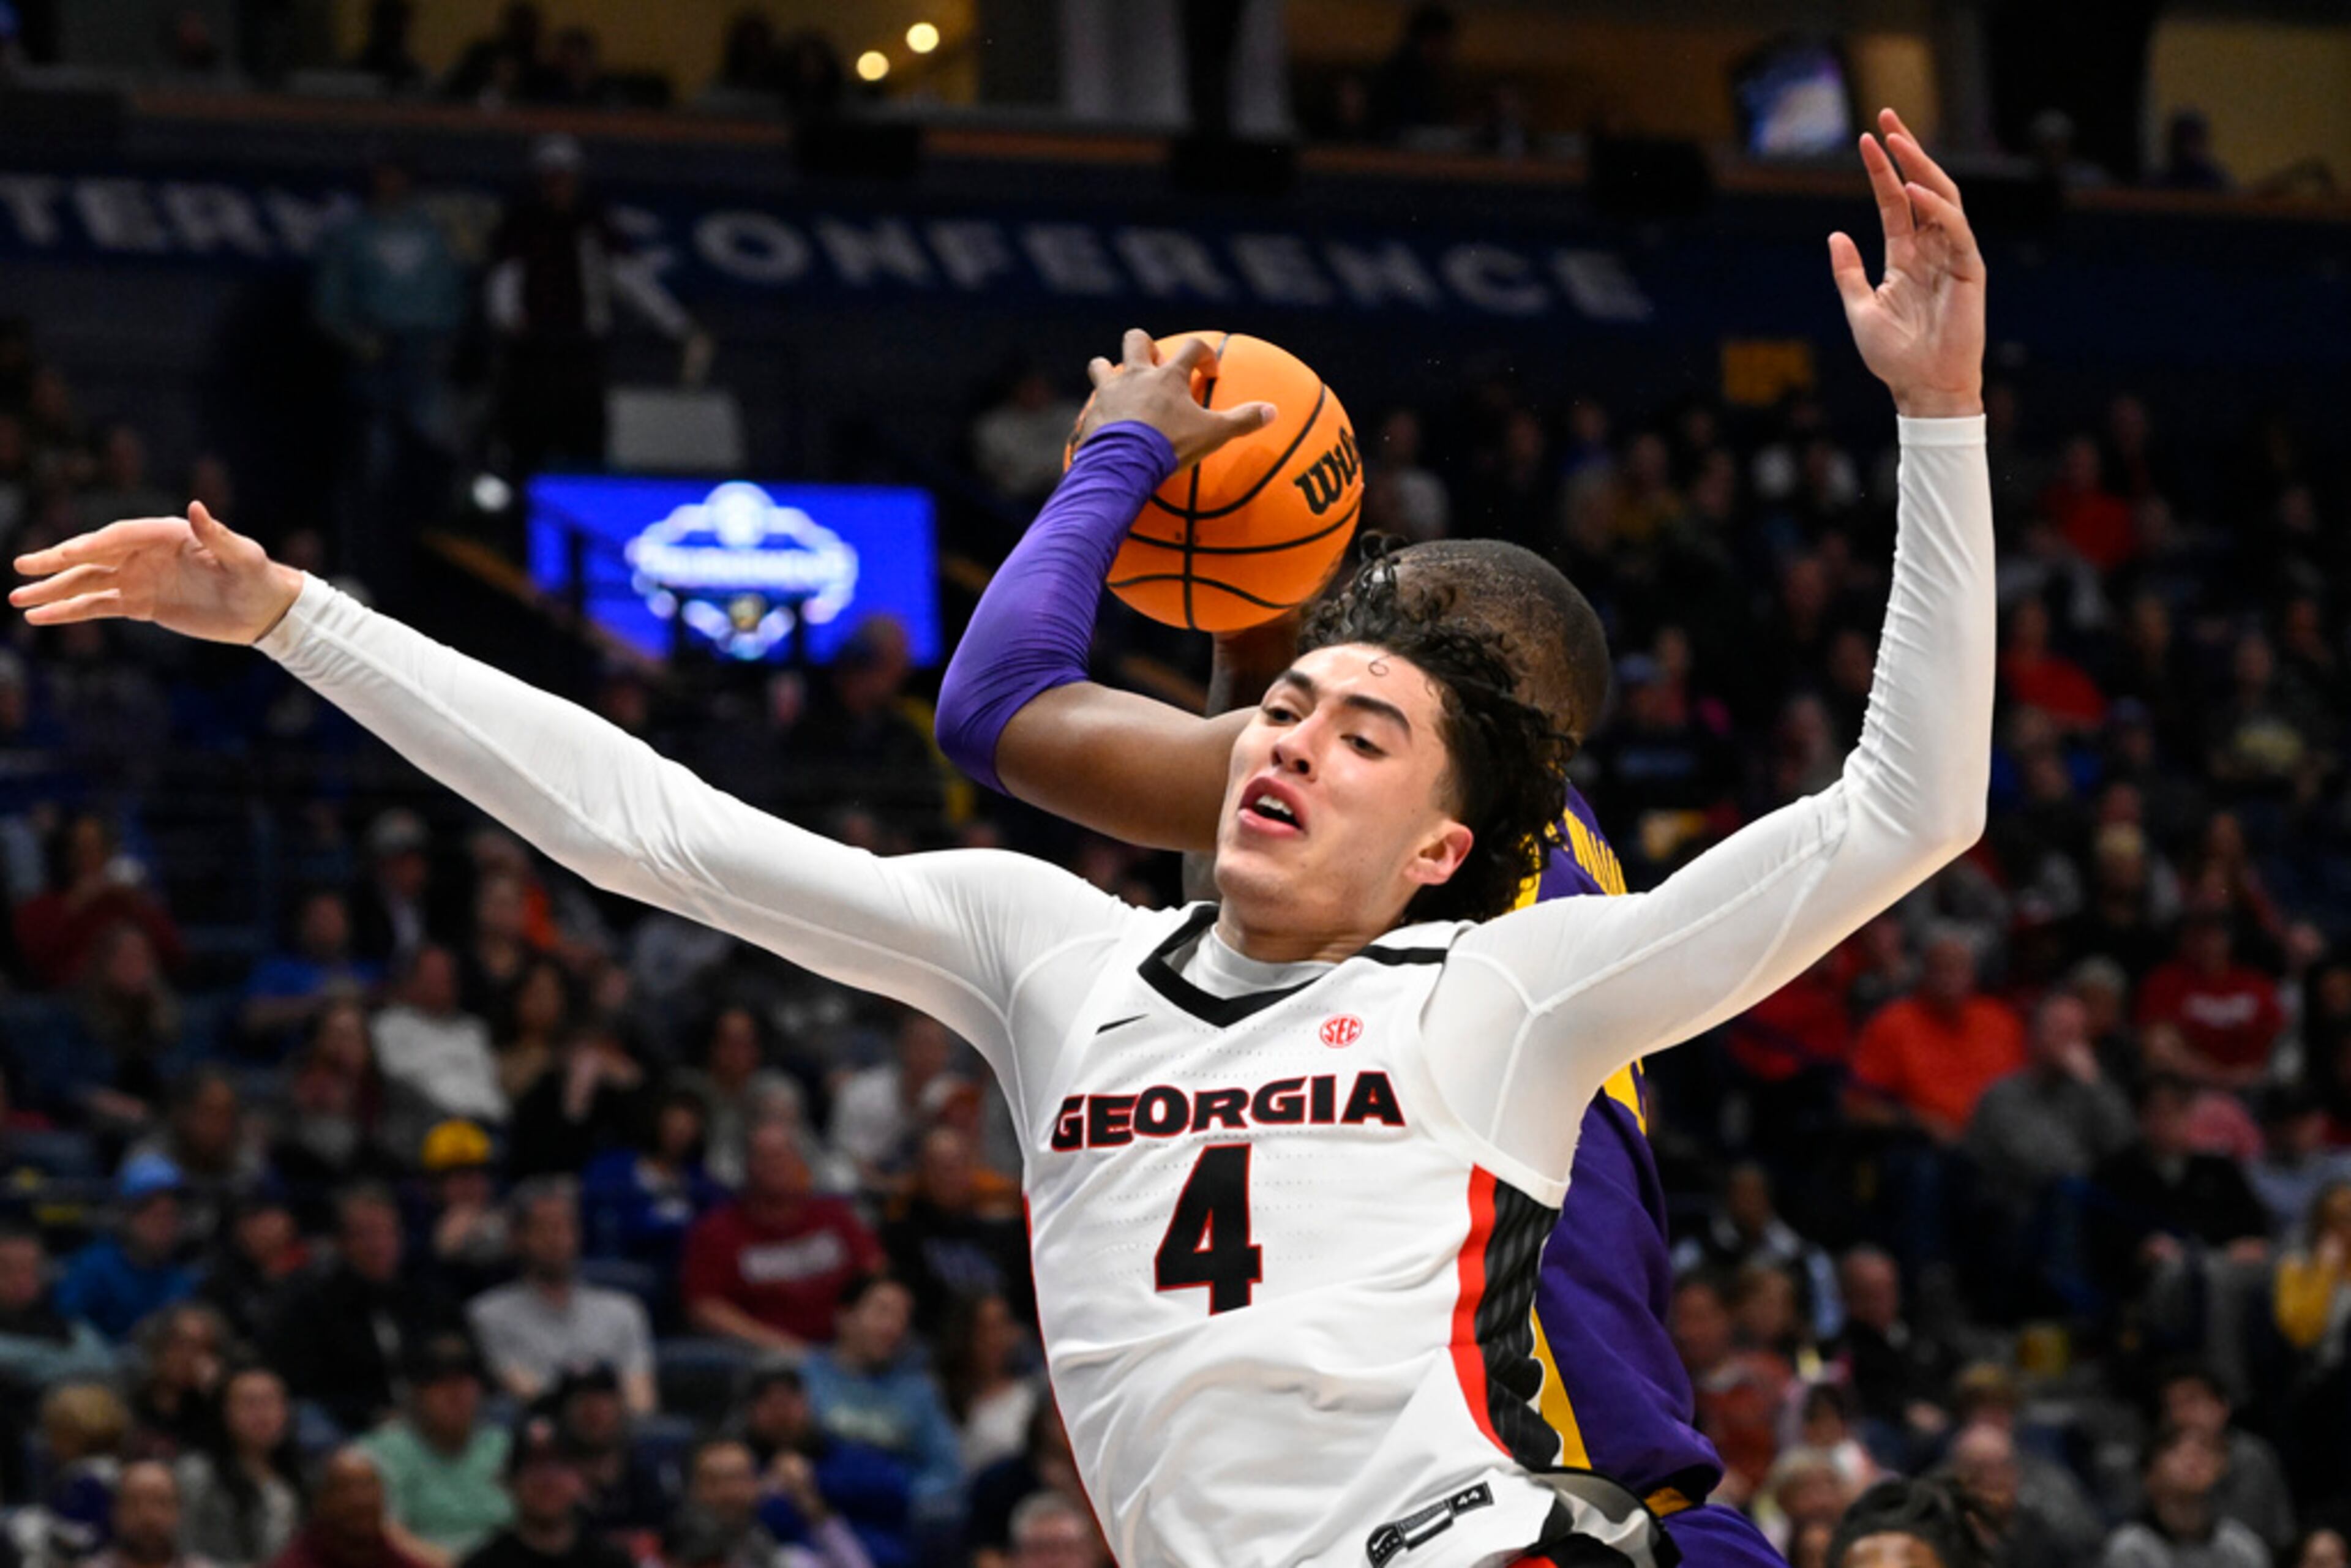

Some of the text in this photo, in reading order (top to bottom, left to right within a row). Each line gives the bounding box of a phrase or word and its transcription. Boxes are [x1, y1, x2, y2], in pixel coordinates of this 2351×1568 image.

[1324, 1018, 1359, 1045] SEC
[1051, 1071, 1406, 1152] GEORGIA
[1154, 1142, 1262, 1316] 4
